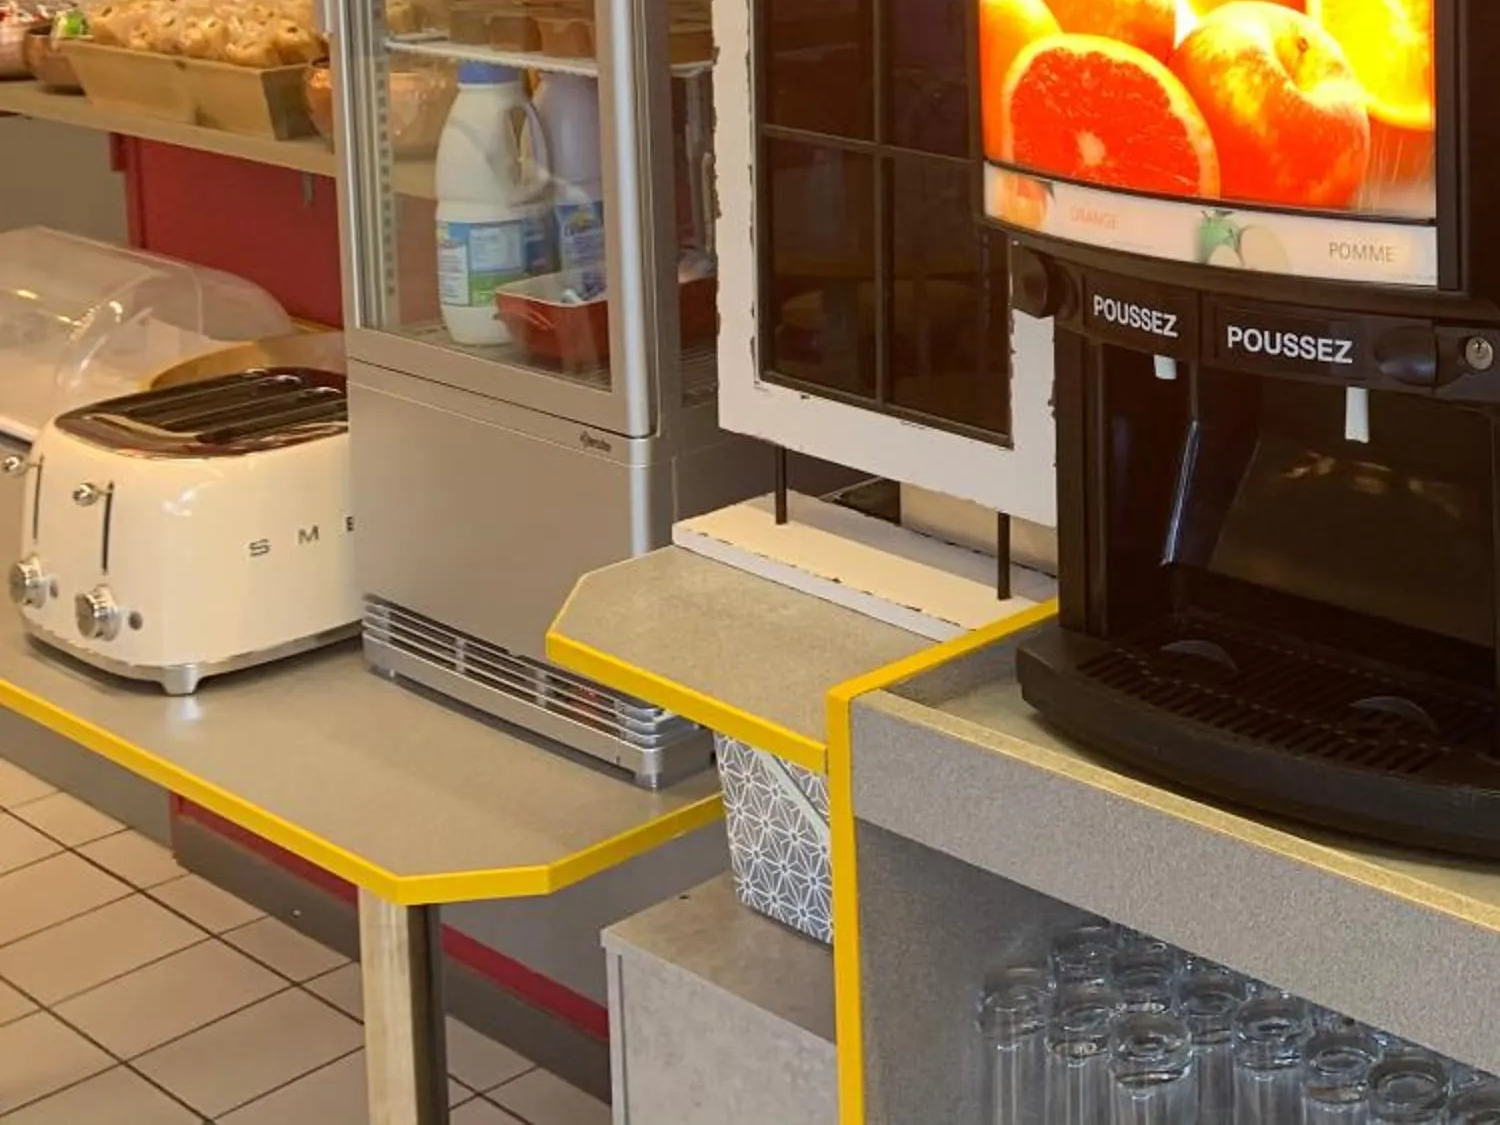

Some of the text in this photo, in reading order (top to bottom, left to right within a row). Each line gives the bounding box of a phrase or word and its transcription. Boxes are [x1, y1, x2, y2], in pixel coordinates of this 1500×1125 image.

[1328, 241, 1397, 263] POMME
[1093, 294, 1178, 338] POUSSEZ
[1226, 324, 1353, 364] POUSSEZ
